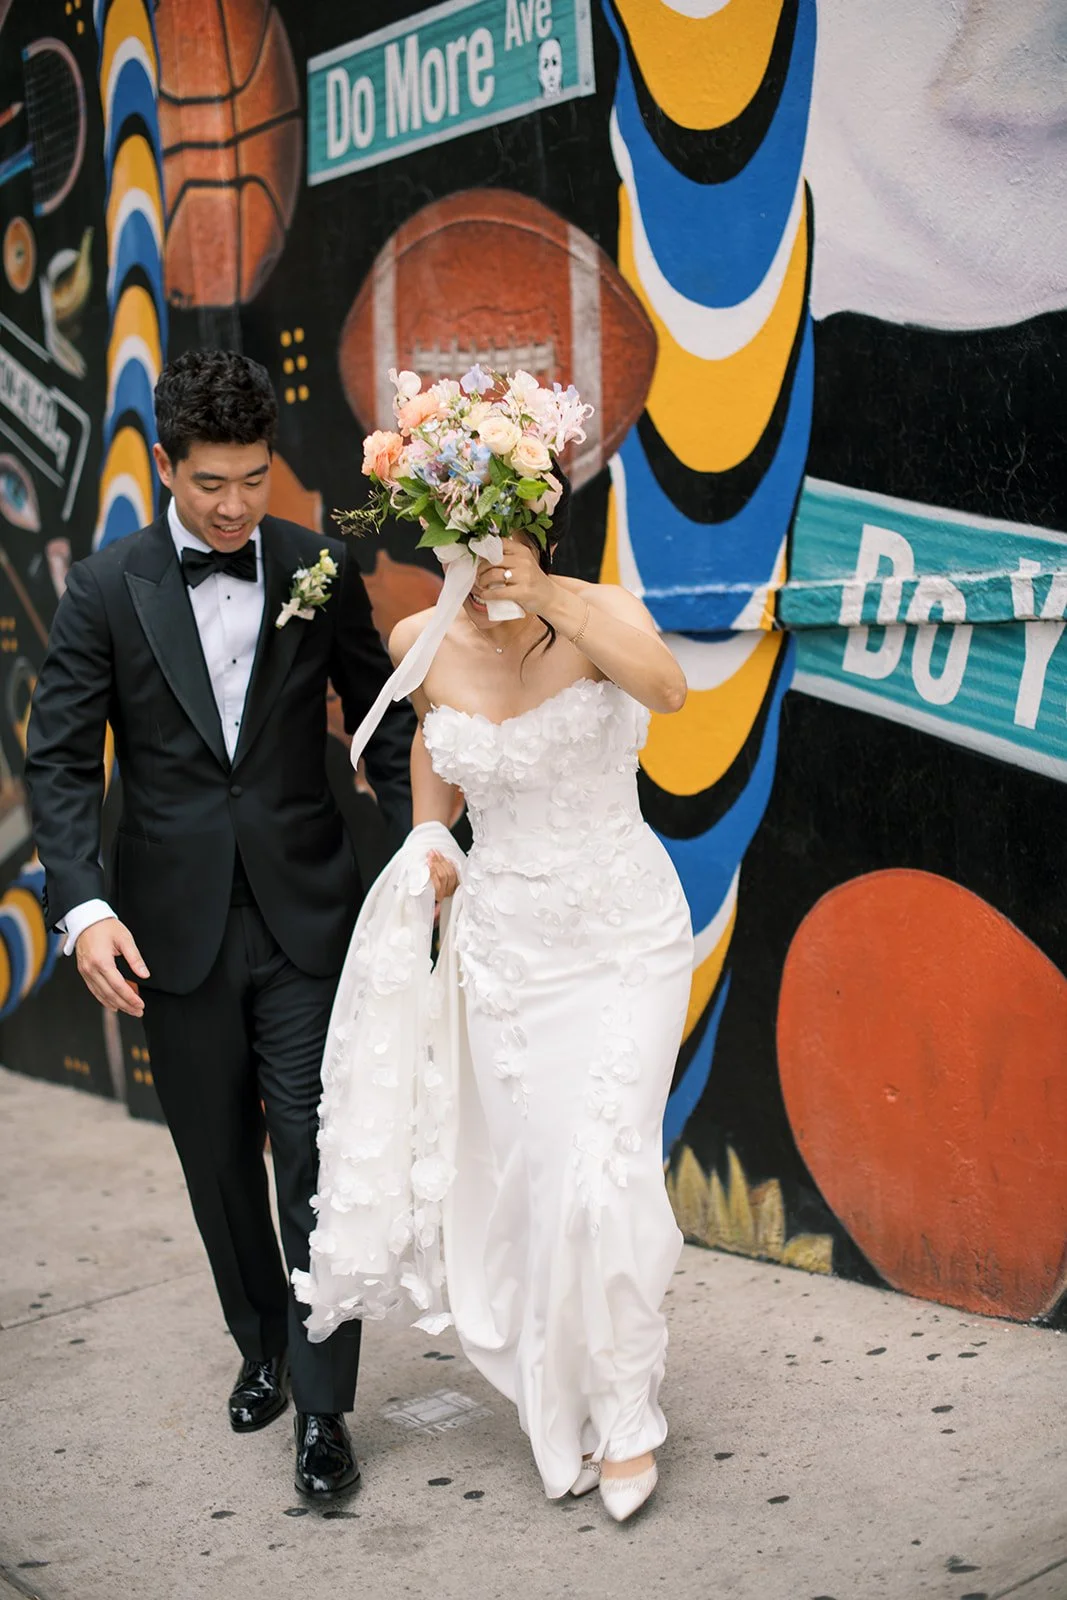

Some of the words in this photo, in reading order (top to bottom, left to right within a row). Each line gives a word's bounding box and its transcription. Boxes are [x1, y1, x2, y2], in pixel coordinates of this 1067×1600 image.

[326, 67, 375, 160] Do
[384, 27, 495, 138] More
[504, 0, 553, 51] Ave
[1010, 556, 1067, 730] Y
